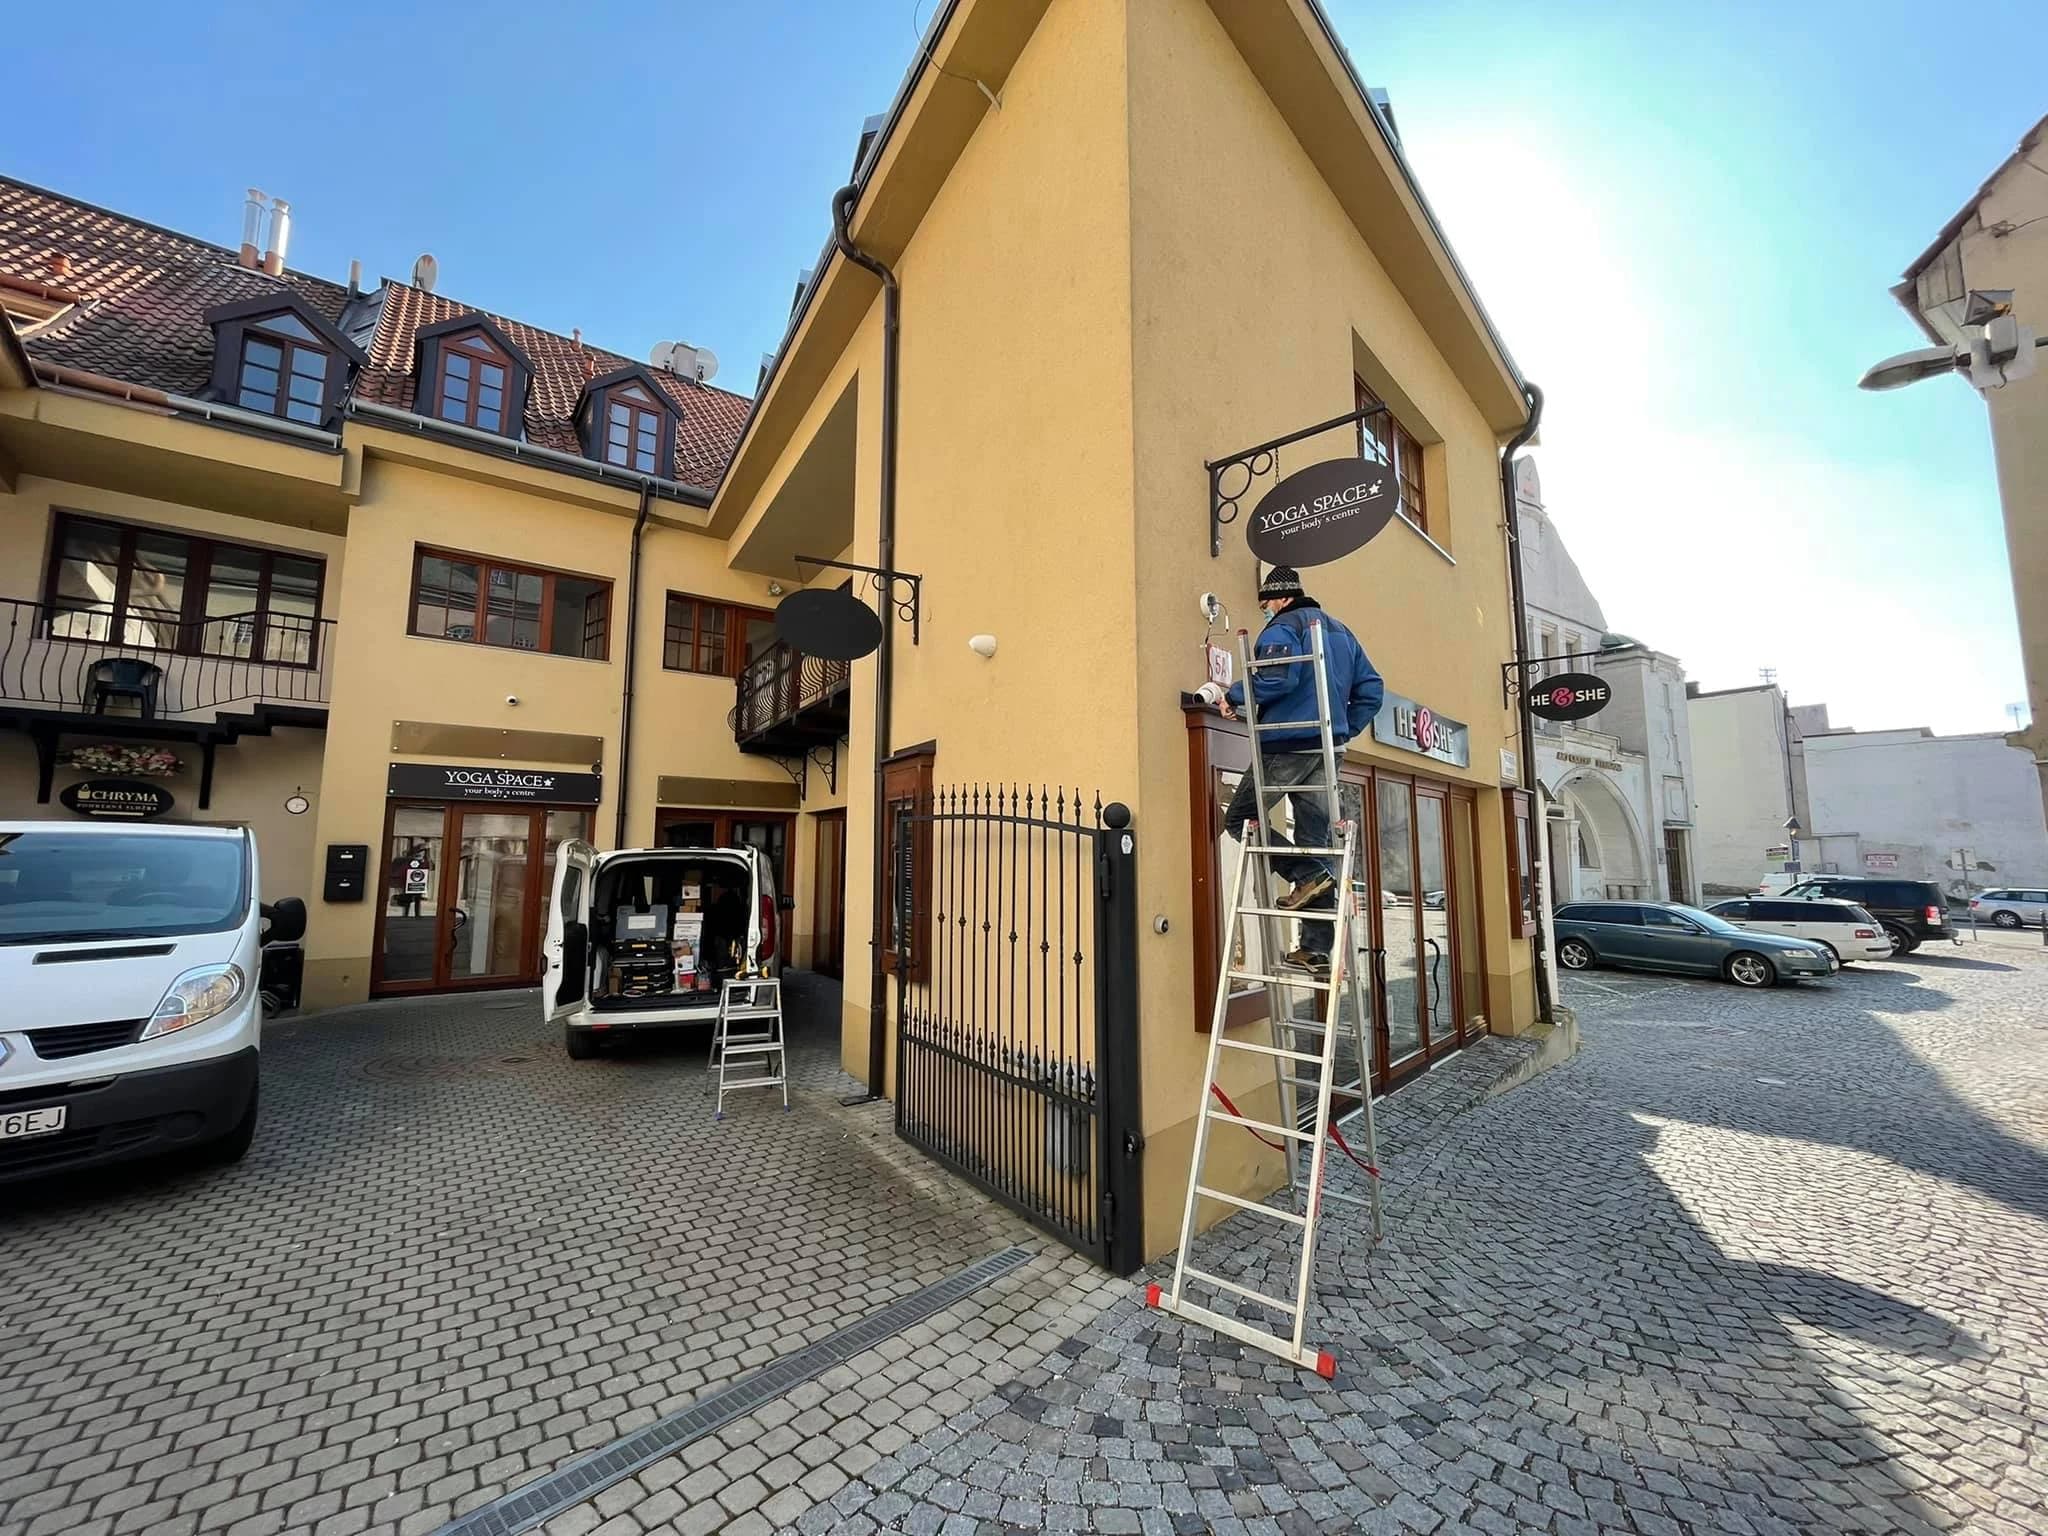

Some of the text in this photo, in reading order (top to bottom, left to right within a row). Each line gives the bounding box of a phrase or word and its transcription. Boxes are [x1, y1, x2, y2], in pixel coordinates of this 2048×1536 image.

[1260, 484, 1368, 529] YOGA SPACE
[1281, 525, 1299, 539] your
[1331, 507, 1361, 521] centre
[1531, 694, 1550, 706] HE
[1575, 688, 1606, 702] SHE
[1394, 706, 1417, 741] HE
[1433, 721, 1453, 752] SHE
[445, 771, 543, 787] YOGA SPACE
[91, 791, 158, 802] CHRYMA
[464, 788, 482, 796] your
[0, 1109, 62, 1134] 6EJ
